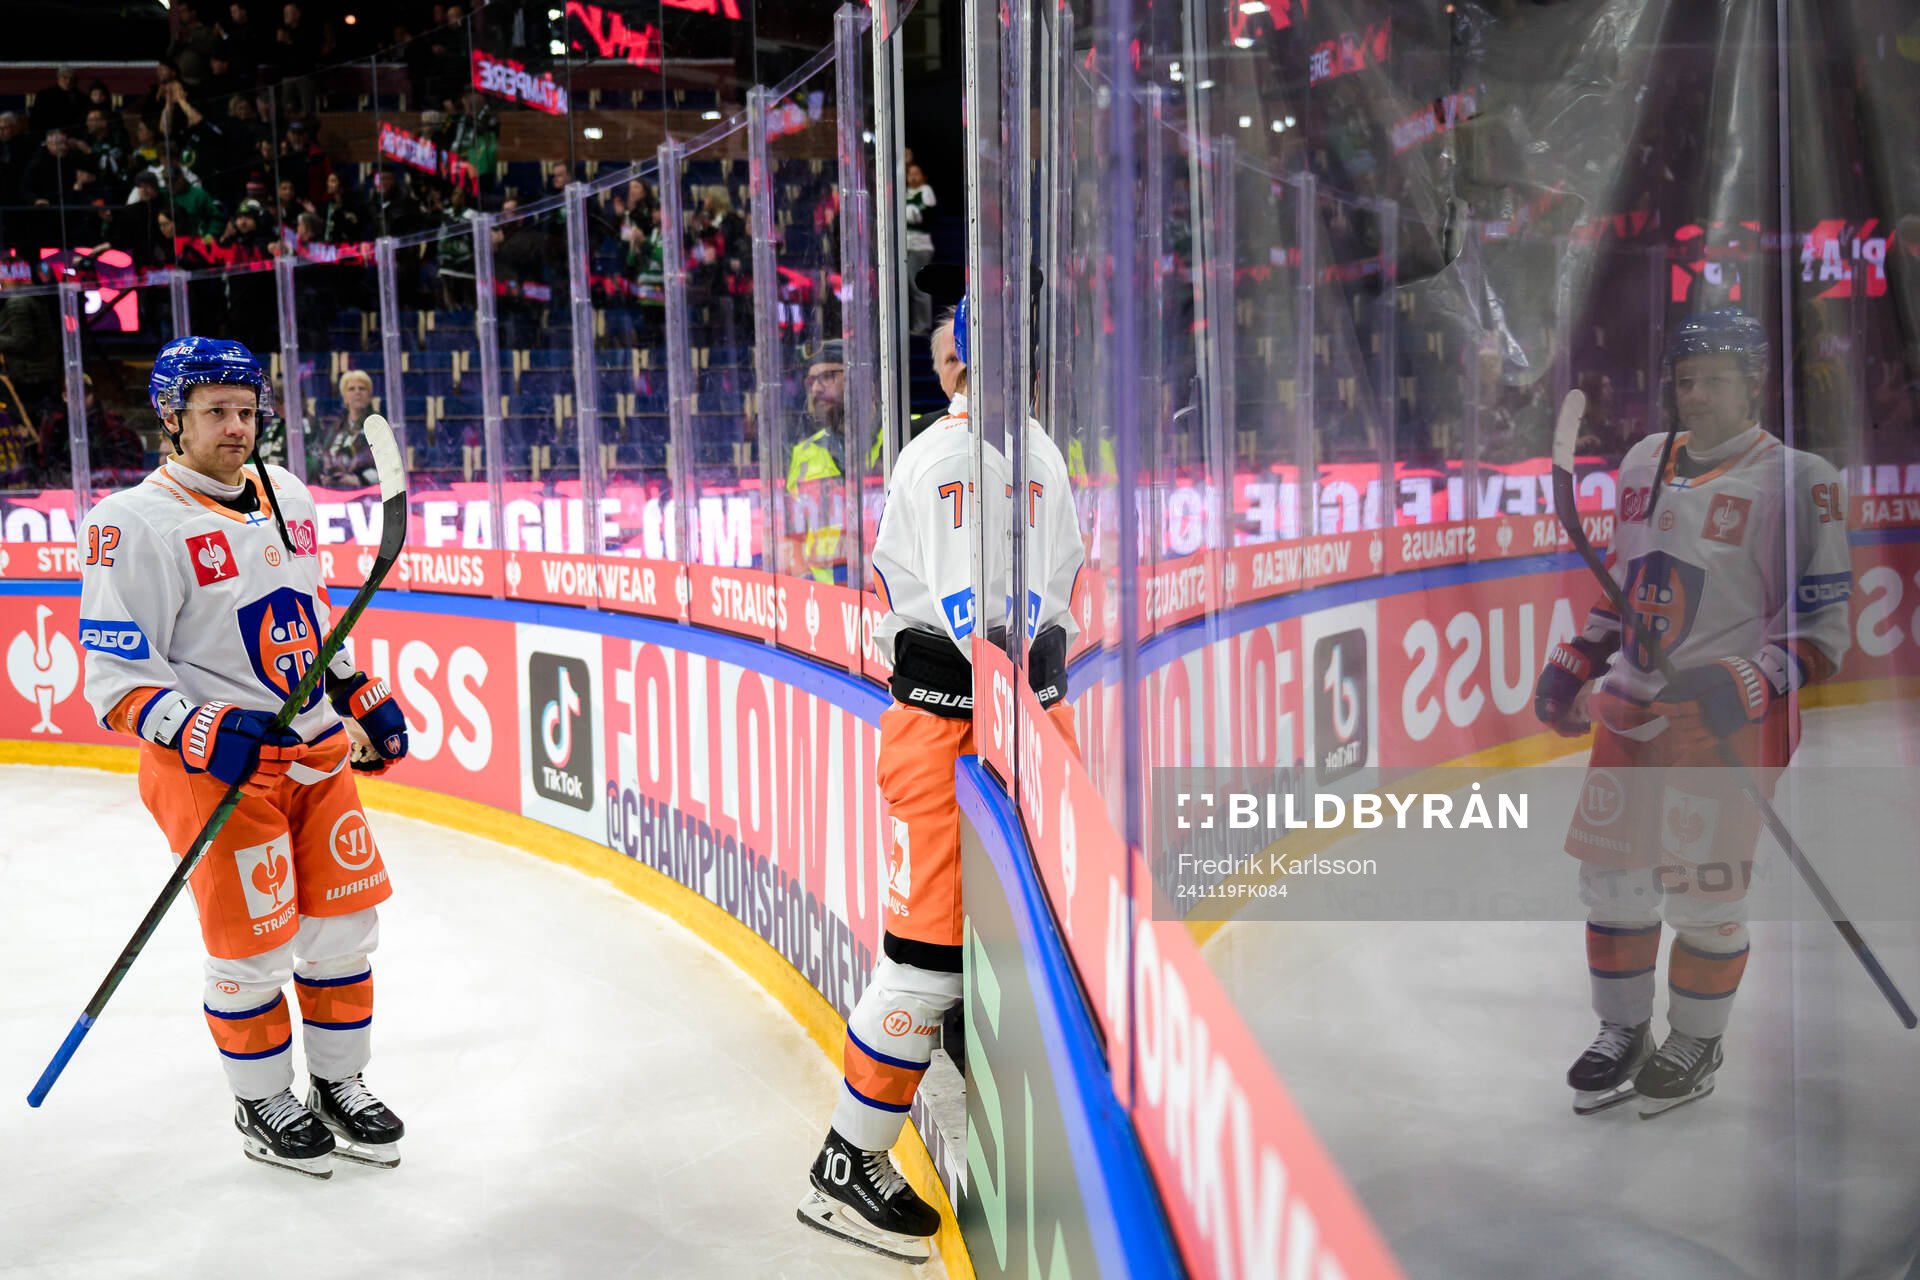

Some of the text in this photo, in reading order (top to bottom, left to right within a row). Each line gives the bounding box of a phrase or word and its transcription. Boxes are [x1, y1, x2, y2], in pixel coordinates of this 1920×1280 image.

[85, 524, 121, 567] 92
[398, 554, 485, 587] STRAUSS
[541, 559, 658, 606] WORKWEAR
[711, 575, 788, 632] STRAUSS
[841, 601, 894, 671] WOR
[541, 766, 584, 799] TikTok
[252, 902, 296, 936] STRAUSS
[823, 1146, 851, 1186] 10
